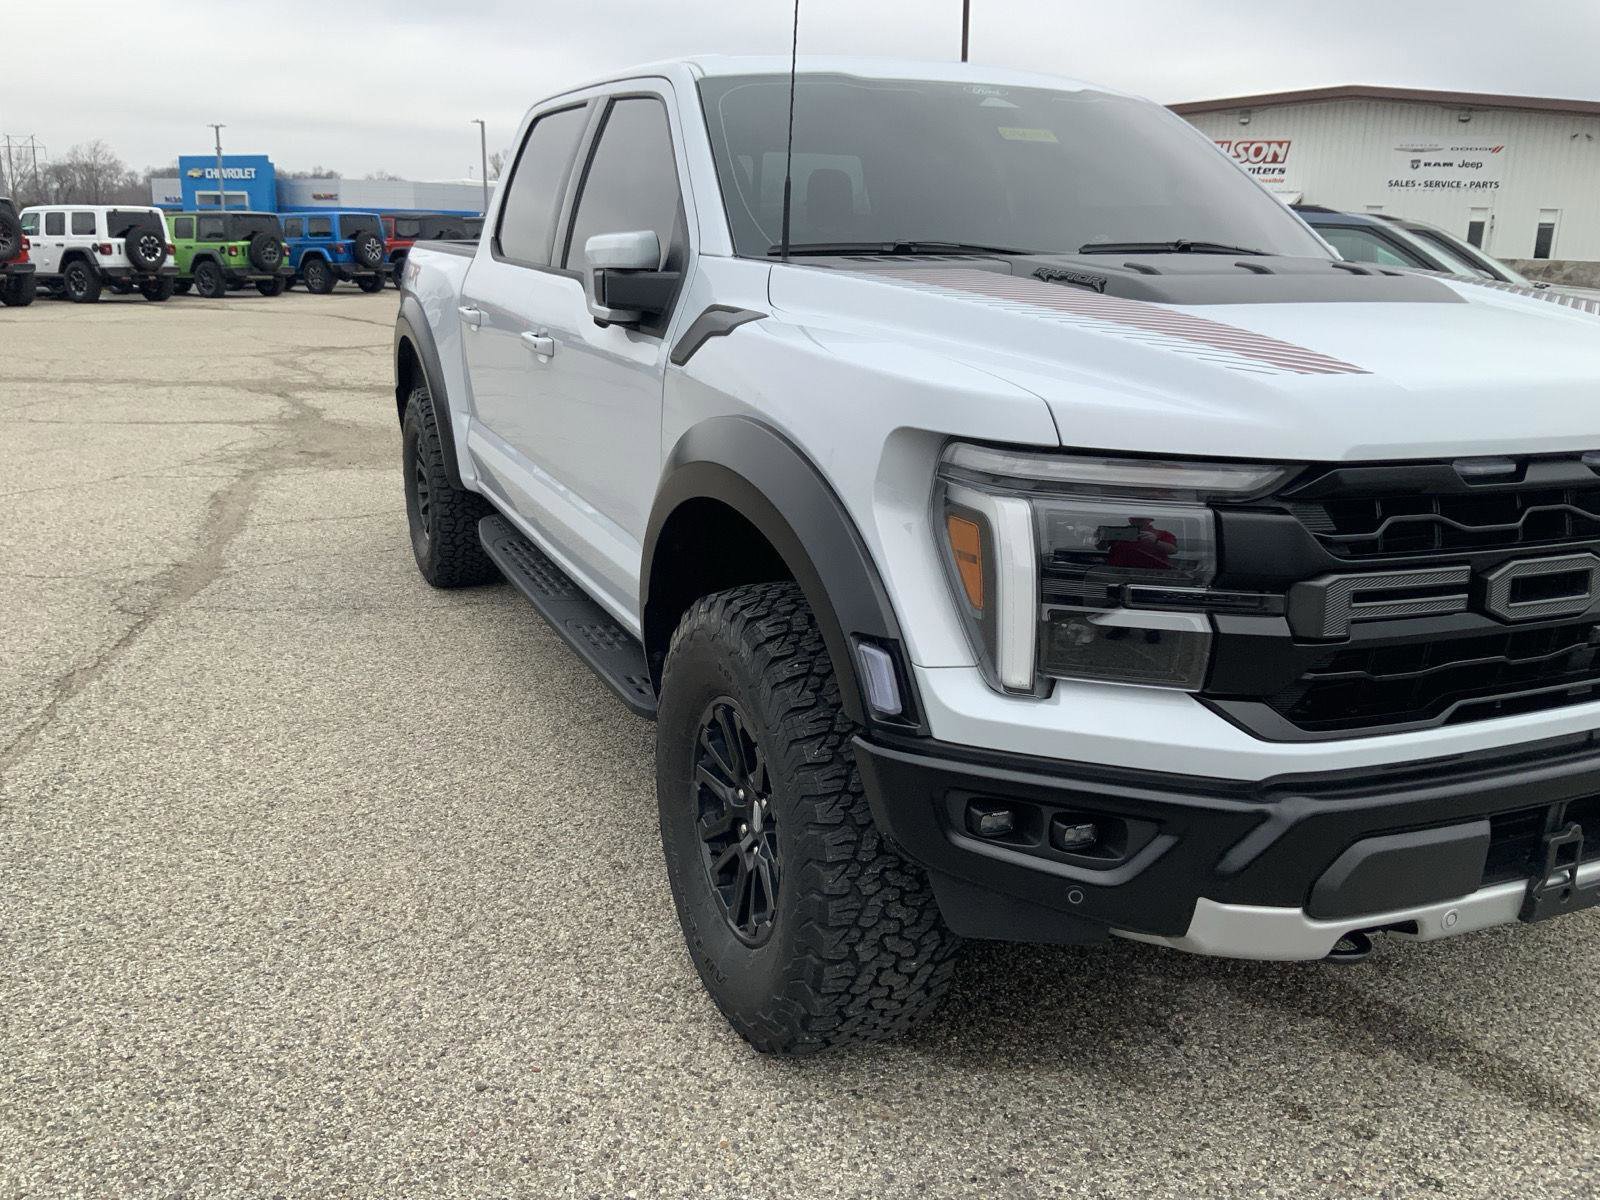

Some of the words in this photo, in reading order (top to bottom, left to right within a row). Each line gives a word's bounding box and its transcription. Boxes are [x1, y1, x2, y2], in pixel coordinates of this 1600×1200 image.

[1458, 160, 1483, 170] Jeep
[1388, 180, 1416, 188] SALES
[1423, 180, 1462, 189] SERVICE
[1469, 180, 1500, 189] PARTS
[1032, 267, 1107, 294] RAPTOR
